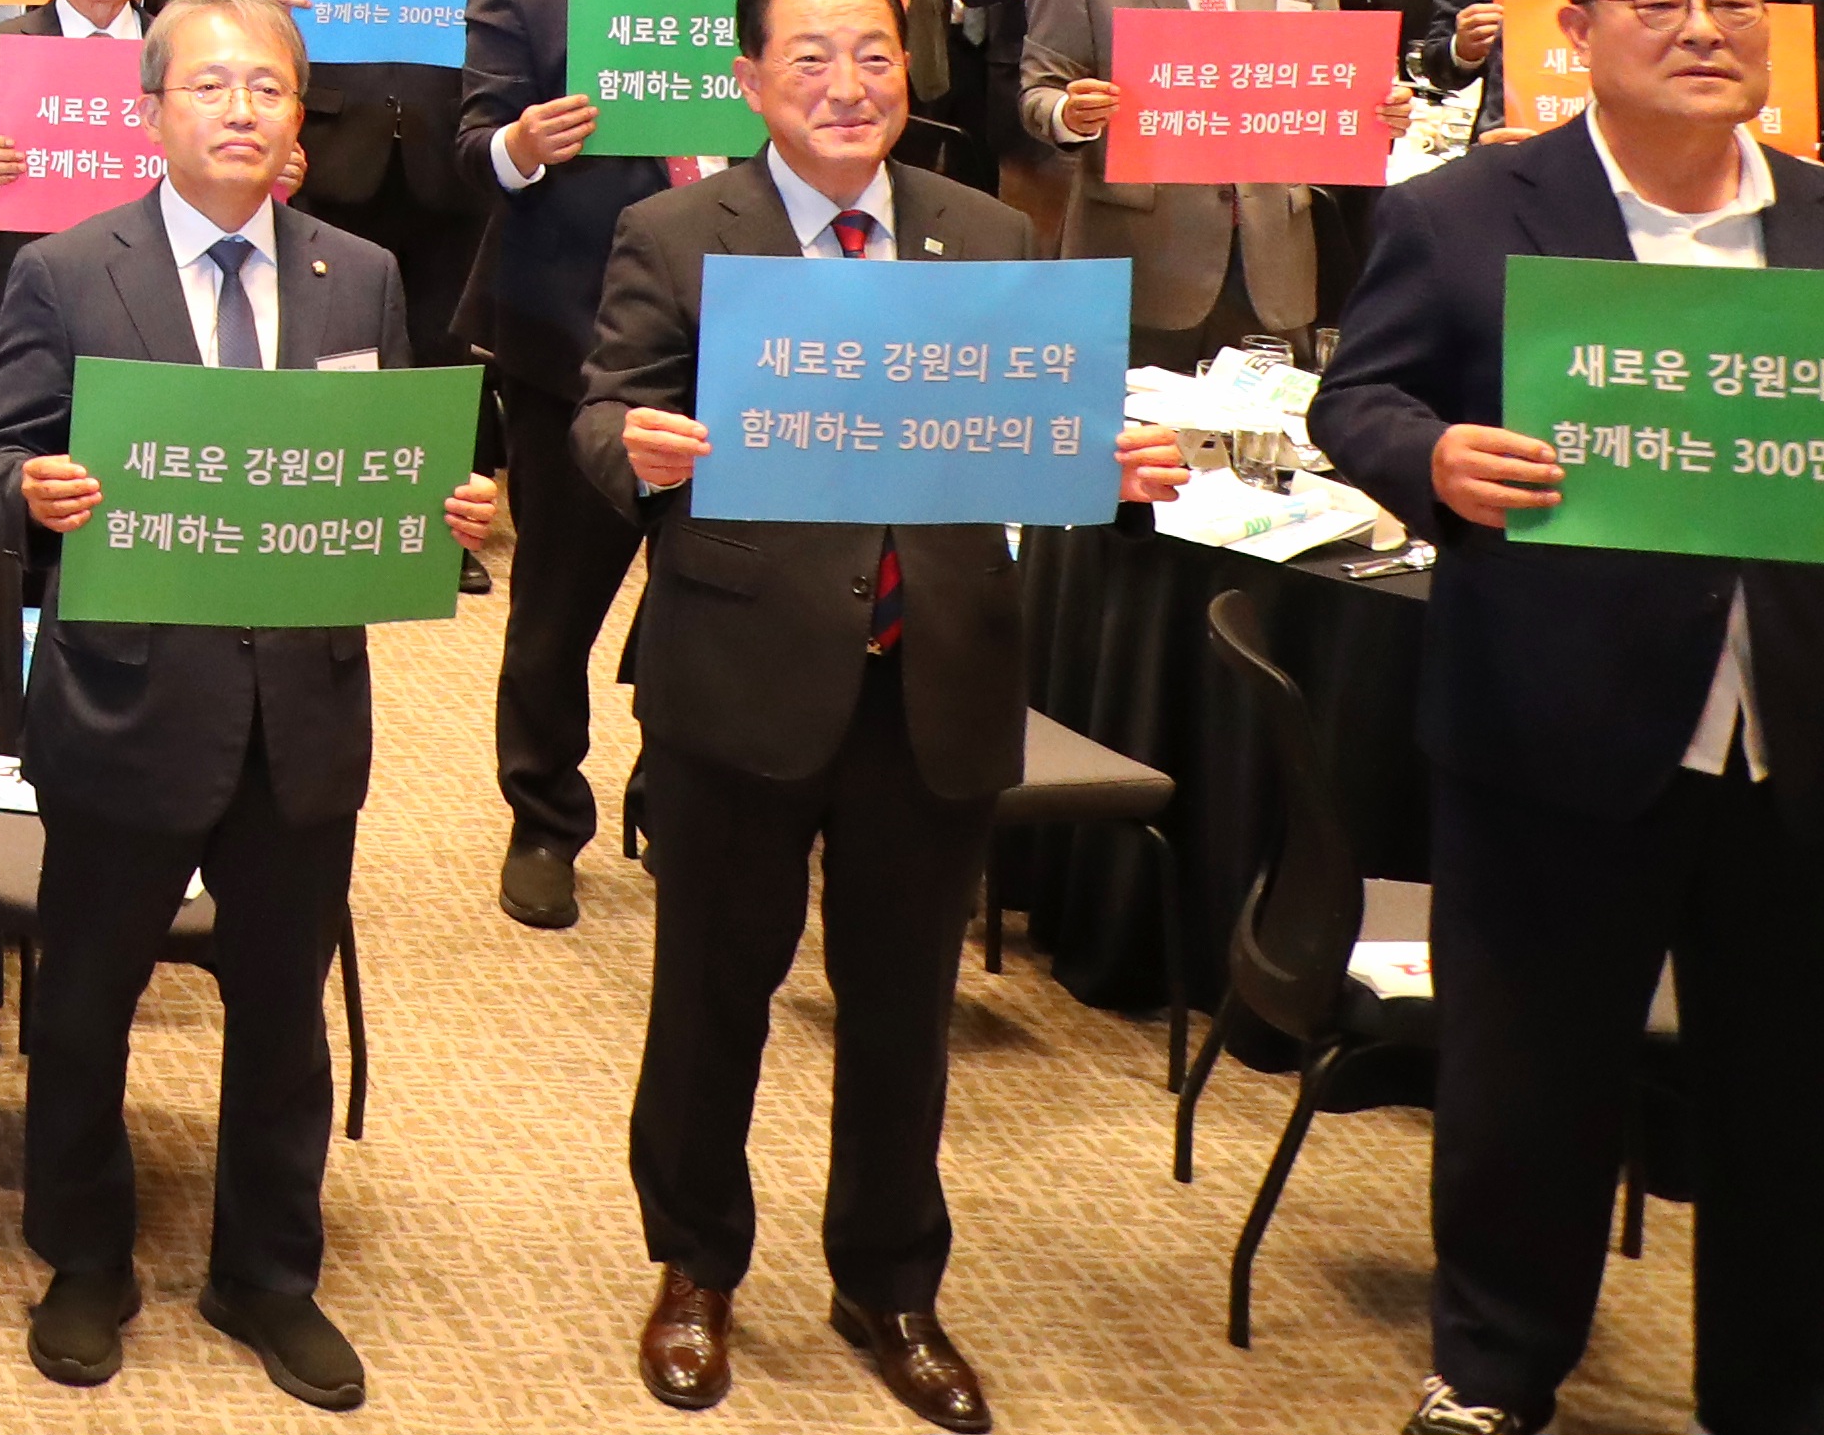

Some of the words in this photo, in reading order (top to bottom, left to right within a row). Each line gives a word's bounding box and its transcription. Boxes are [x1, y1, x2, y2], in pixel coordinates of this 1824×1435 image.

[312, 0, 391, 24] 함께하는
[608, 15, 680, 45] 새로운
[598, 70, 692, 101] 함께하는
[1149, 63, 1220, 89] 새로운
[1230, 63, 1297, 89] 강원의
[1307, 63, 1356, 89] 도약
[36, 96, 110, 125] 새로운
[1139, 110, 1231, 136] 함께하는
[1239, 109, 1326, 135] 300만의
[1337, 110, 1358, 136] 힘
[26, 148, 124, 179] 함께하는
[757, 338, 866, 378] 새로운
[882, 342, 988, 382] 강원의
[1003, 344, 1075, 382] 도약
[1567, 345, 1690, 391] 새로운
[741, 409, 885, 450] 함께하는
[898, 416, 1033, 454] 300만의
[1050, 416, 1081, 454] 힘
[1548, 421, 1716, 476] 함께하는
[124, 442, 228, 482] 새로운
[244, 448, 344, 487] 강원의
[358, 447, 424, 484] 도약
[107, 509, 244, 553] 함께하는
[258, 517, 383, 555] 300만의
[399, 515, 426, 553] 힘
